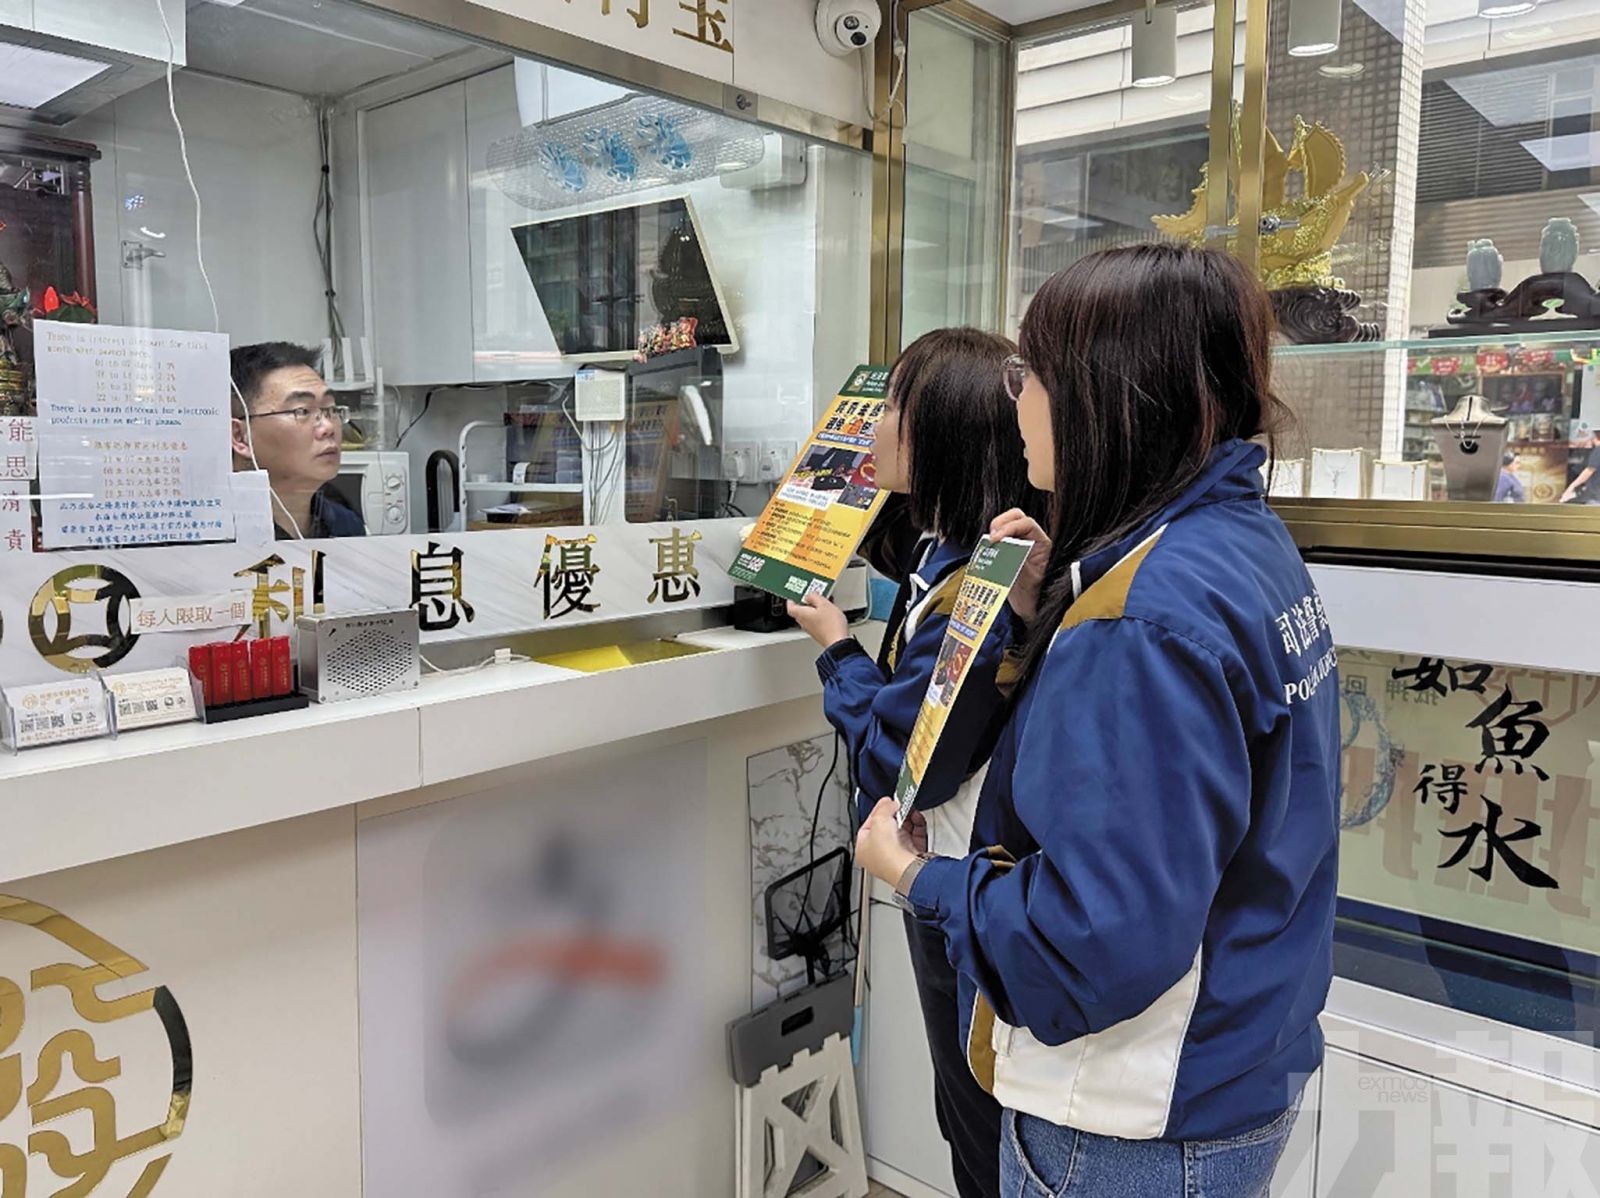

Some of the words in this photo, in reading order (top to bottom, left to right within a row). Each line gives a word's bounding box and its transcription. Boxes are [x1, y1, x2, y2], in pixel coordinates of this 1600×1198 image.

[138, 601, 246, 629] 每人限取一個
[234, 527, 703, 640] 利息優惠
[1391, 656, 1560, 889] 如魚得水
